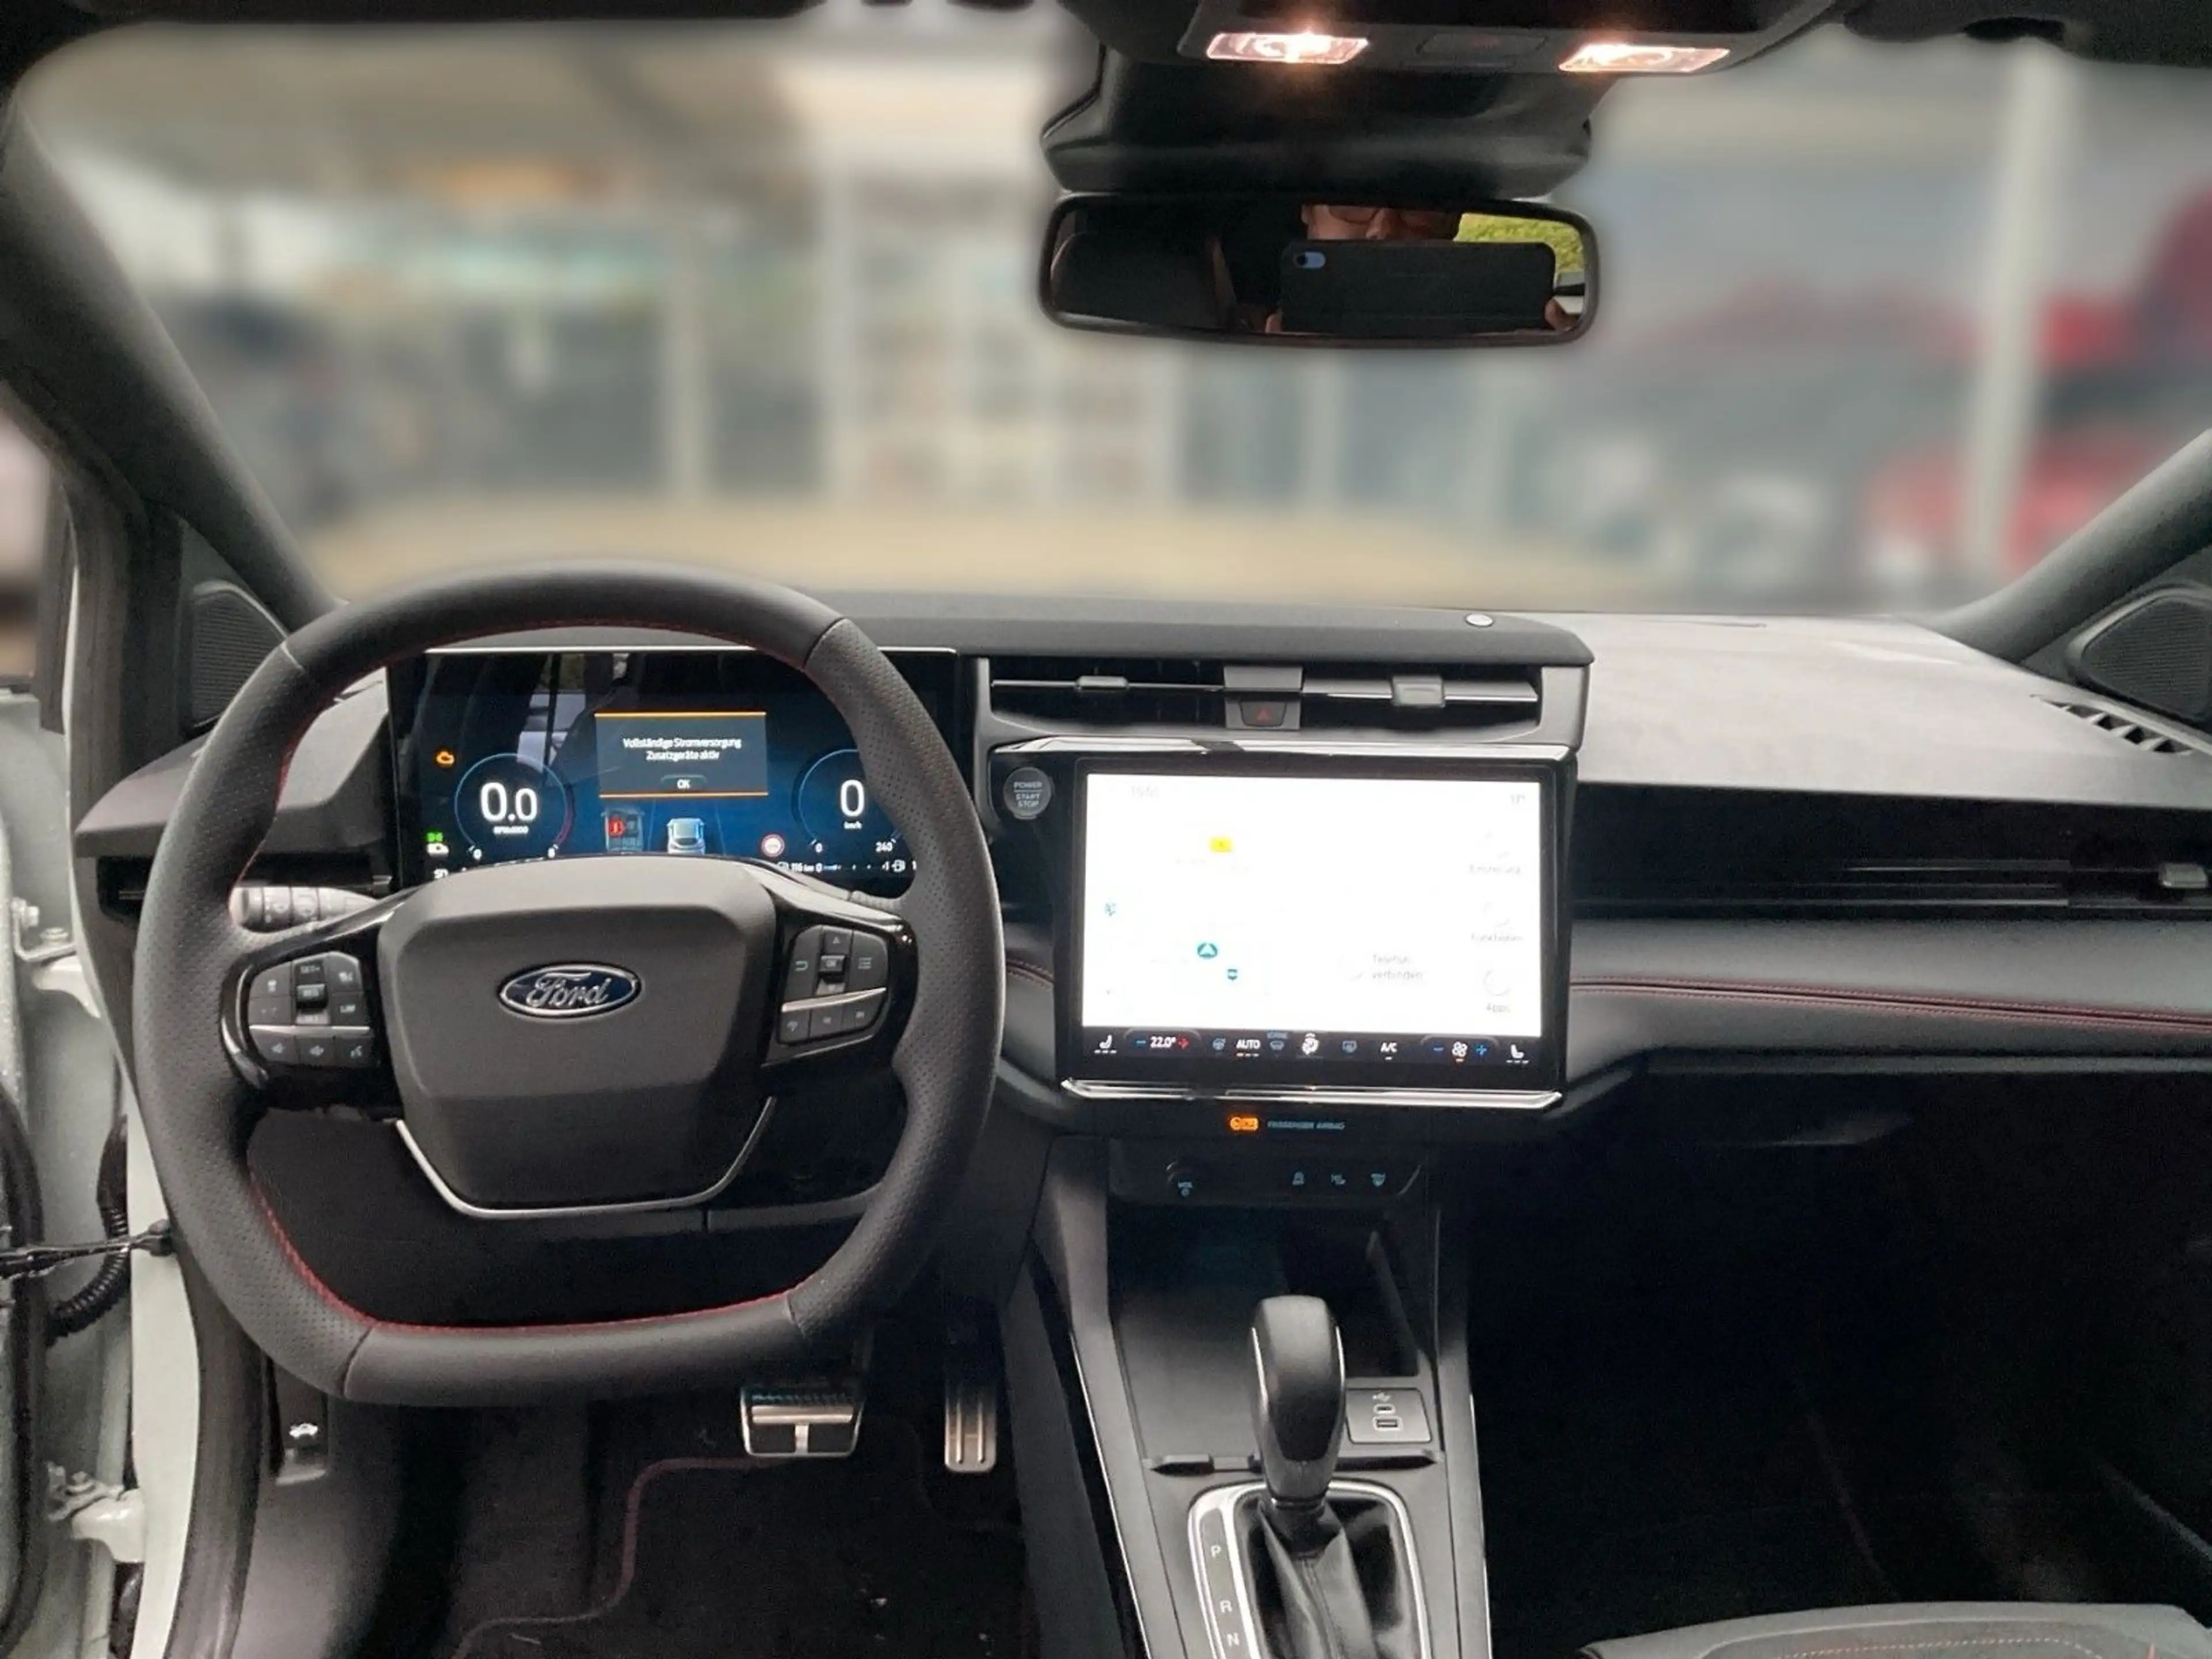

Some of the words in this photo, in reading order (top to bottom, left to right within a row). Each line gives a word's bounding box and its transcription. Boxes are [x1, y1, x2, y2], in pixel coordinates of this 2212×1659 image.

[674, 738, 741, 749] Stromversorgung
[646, 751, 699, 761] Zusatzgeräte
[700, 751, 719, 760] aktiv
[677, 779, 690, 789] OK
[480, 782, 537, 821] 0.0
[840, 779, 864, 817] 0
[815, 843, 823, 853] 0
[526, 972, 612, 1007] Ford
[1150, 1036, 1177, 1049] 22.0°
[1236, 1039, 1261, 1049] AUTO
[1380, 1041, 1397, 1053] A/C
[1211, 1545, 1221, 1558] P
[1219, 1600, 1233, 1613] R
[1227, 1633, 1240, 1647] N
